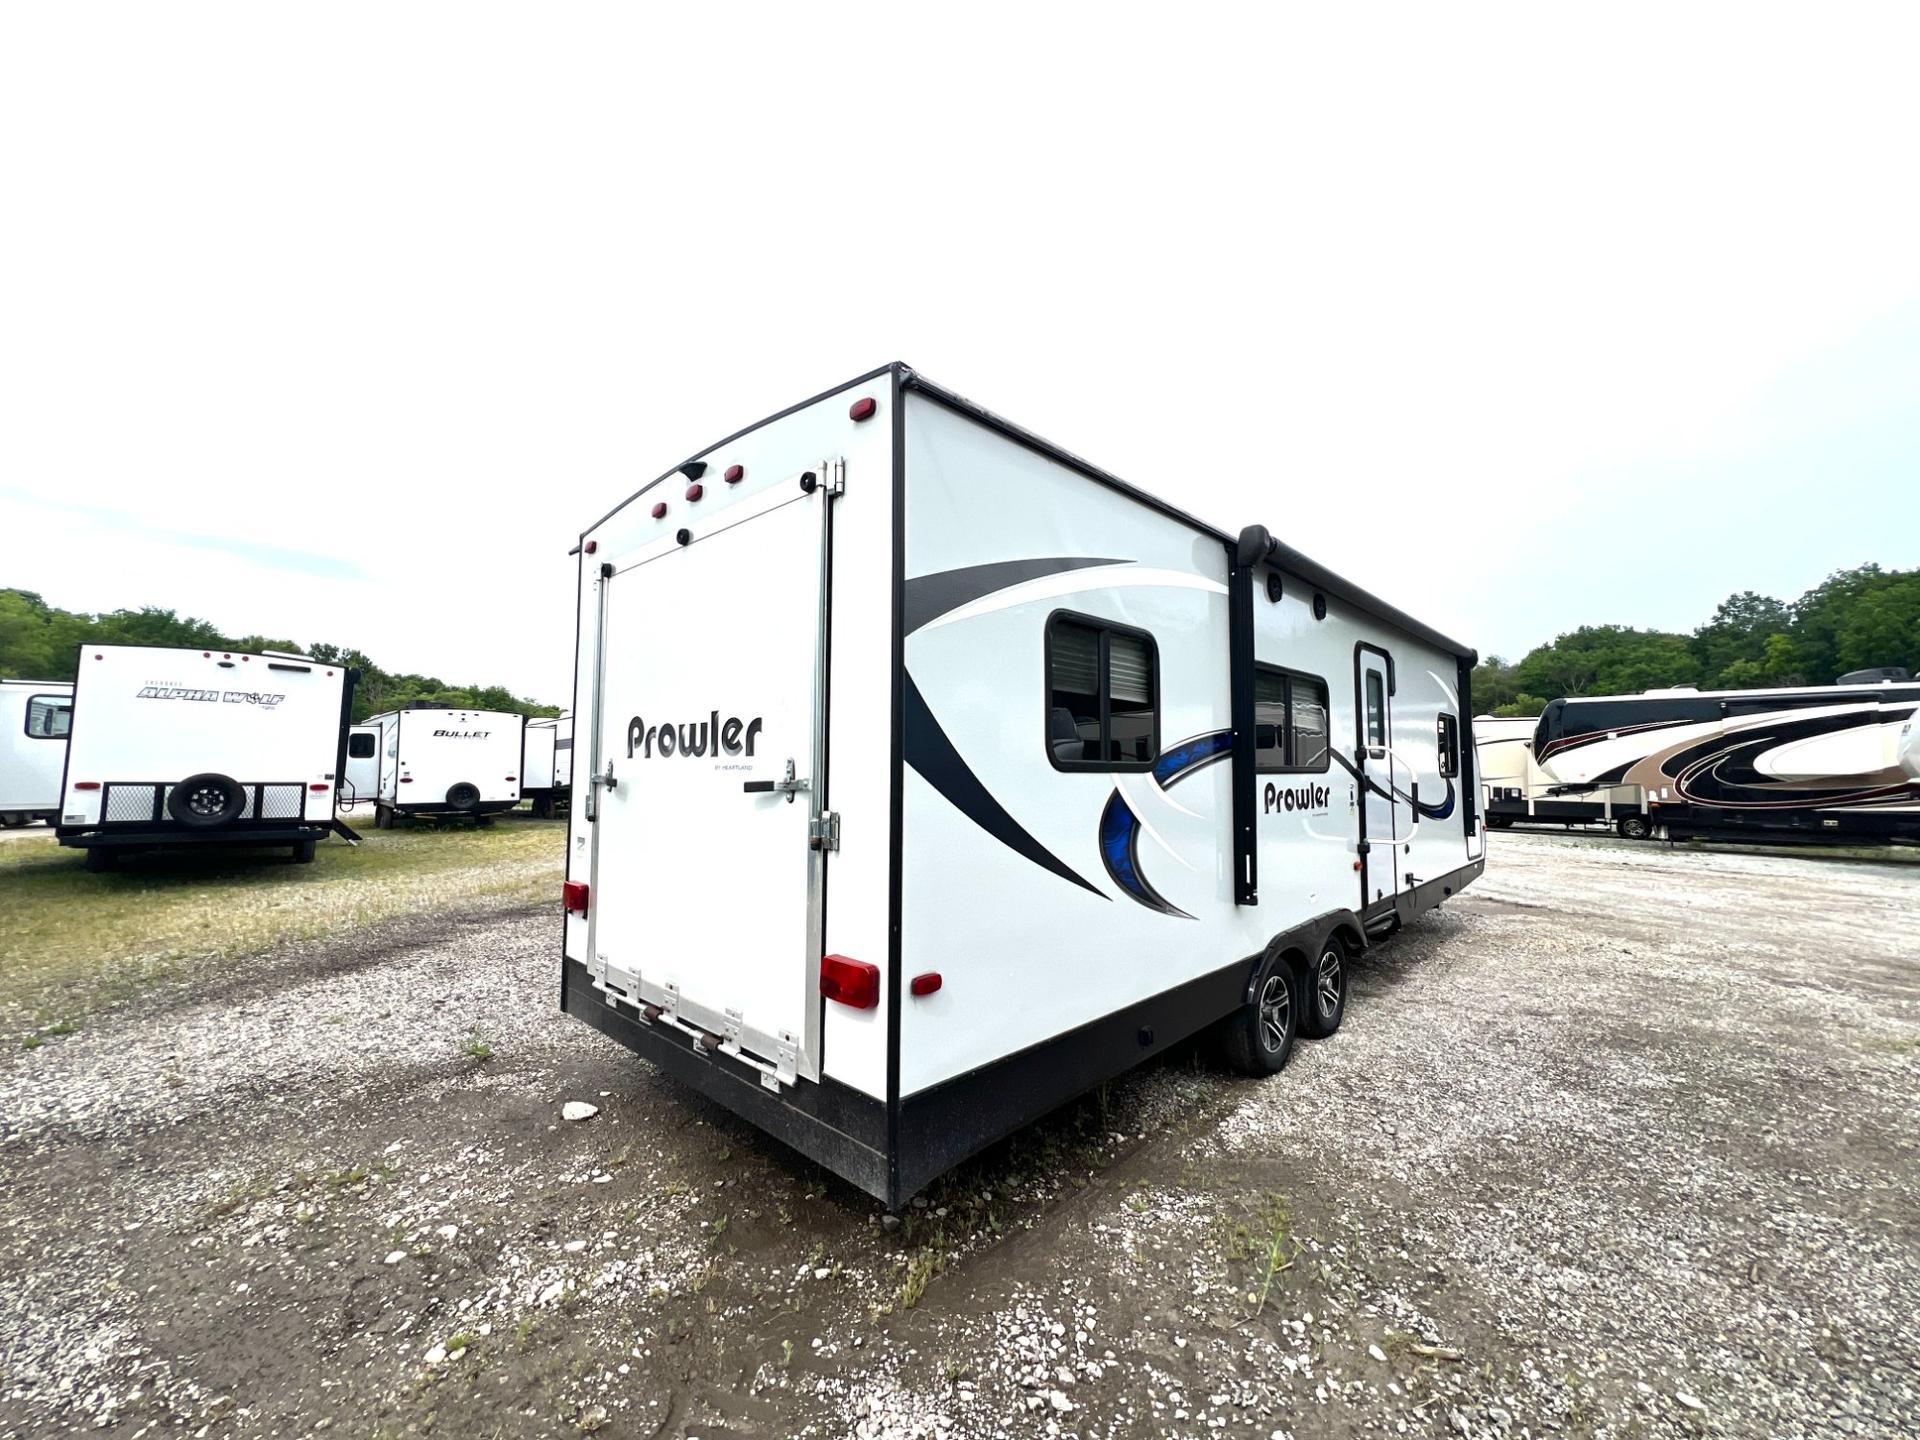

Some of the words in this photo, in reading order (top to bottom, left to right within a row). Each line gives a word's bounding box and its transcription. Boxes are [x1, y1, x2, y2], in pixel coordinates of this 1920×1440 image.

[136, 686, 219, 702] ALPHA
[433, 730, 492, 738] BULLET
[627, 710, 762, 759] Prowler
[1264, 782, 1330, 814] Prowler
